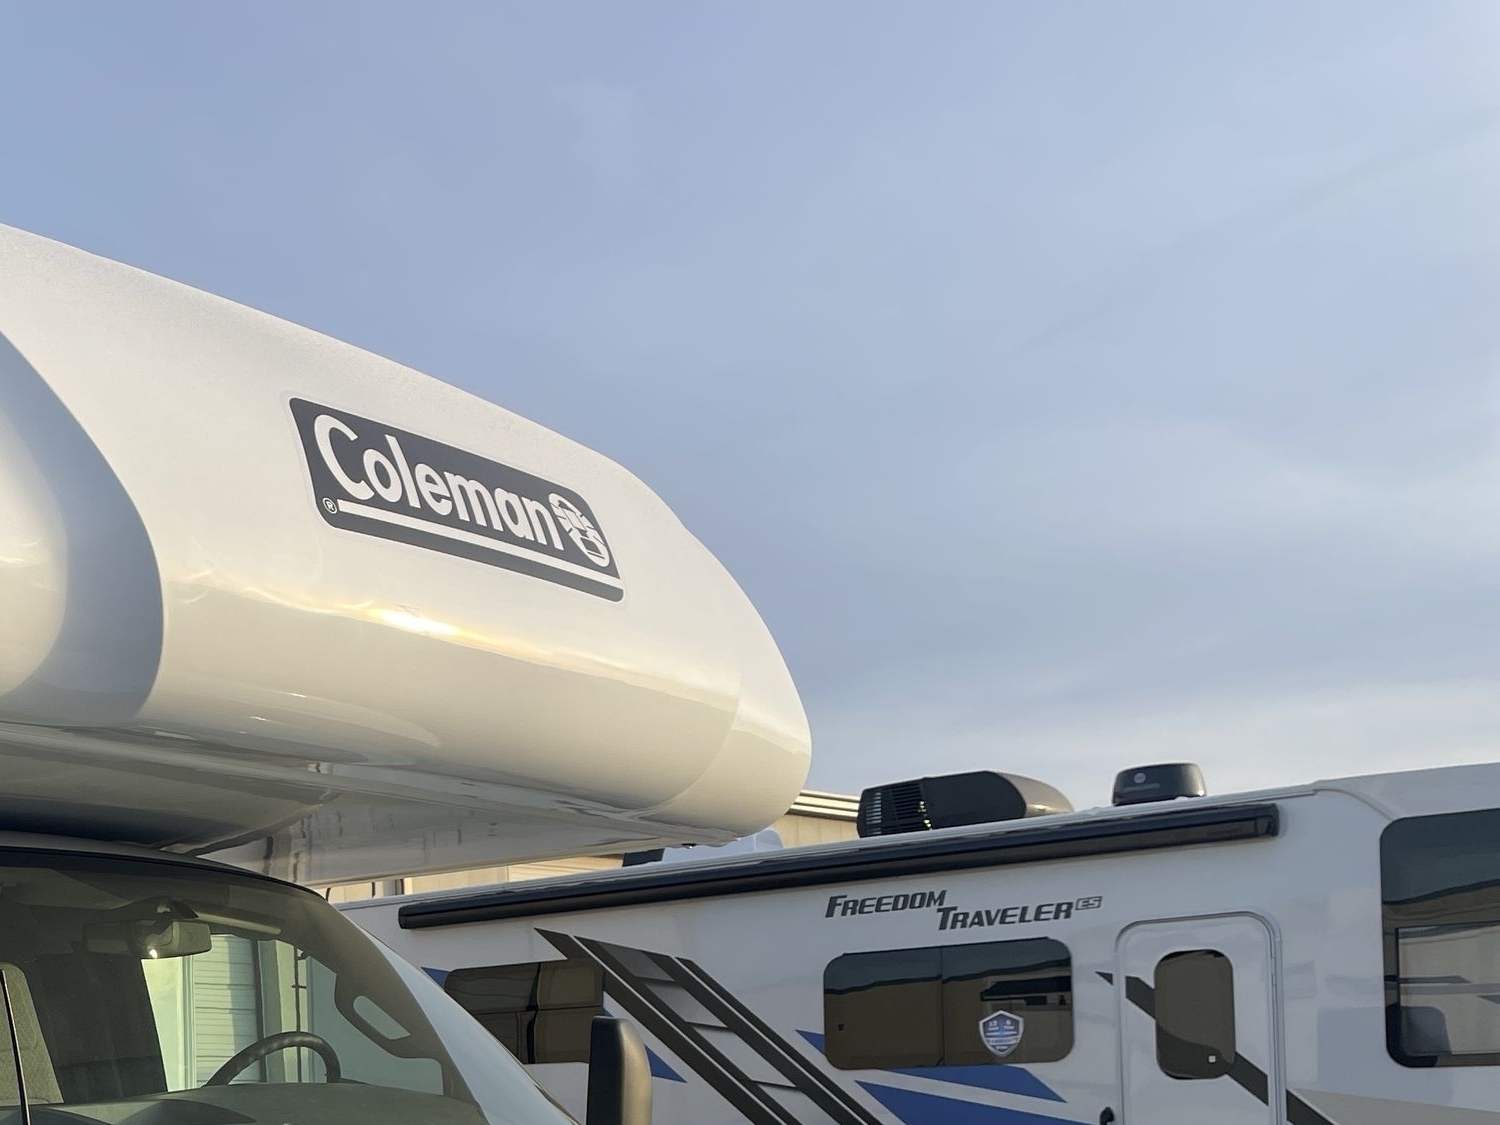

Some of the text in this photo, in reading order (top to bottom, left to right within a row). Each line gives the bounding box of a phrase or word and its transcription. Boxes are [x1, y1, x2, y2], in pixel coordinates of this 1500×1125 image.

[314, 414, 564, 551] Coleman
[825, 889, 947, 918] FREEDOM
[937, 896, 1102, 931] TRAVELER ES
